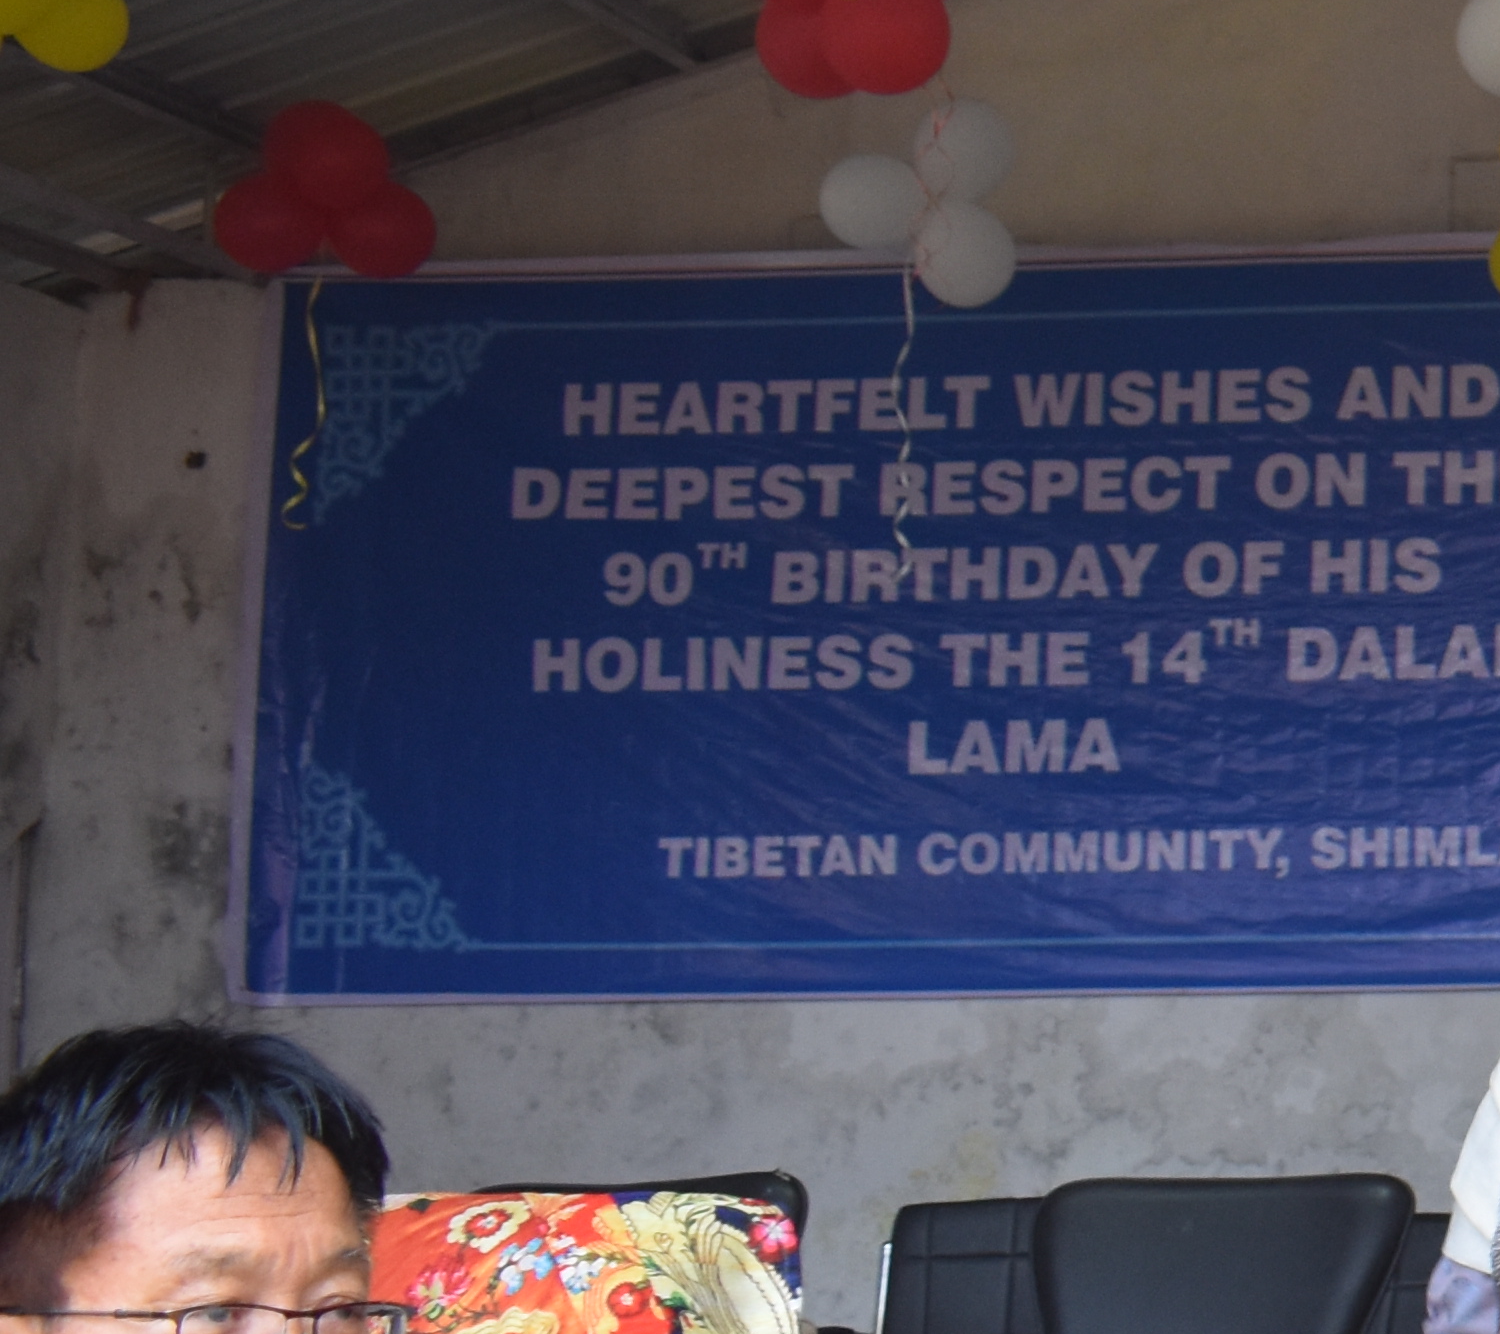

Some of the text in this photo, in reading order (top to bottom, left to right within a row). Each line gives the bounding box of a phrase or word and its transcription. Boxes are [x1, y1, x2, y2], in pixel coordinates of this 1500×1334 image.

[564, 364, 1500, 435] HEARTFELT WISHES AND
[512, 465, 854, 520] DEEPEST
[880, 453, 1231, 522] RESPECT
[1256, 453, 1365, 509] ON
[604, 538, 1440, 605] 90TH BIRTHDAY OF HIS
[534, 634, 914, 692] HOLINESS
[940, 632, 1088, 686] THE
[1122, 619, 1260, 683] 14TH
[908, 719, 1120, 775] LAMA
[659, 835, 897, 877] TIBETAN
[918, 828, 1289, 878] COMMUNITY,
